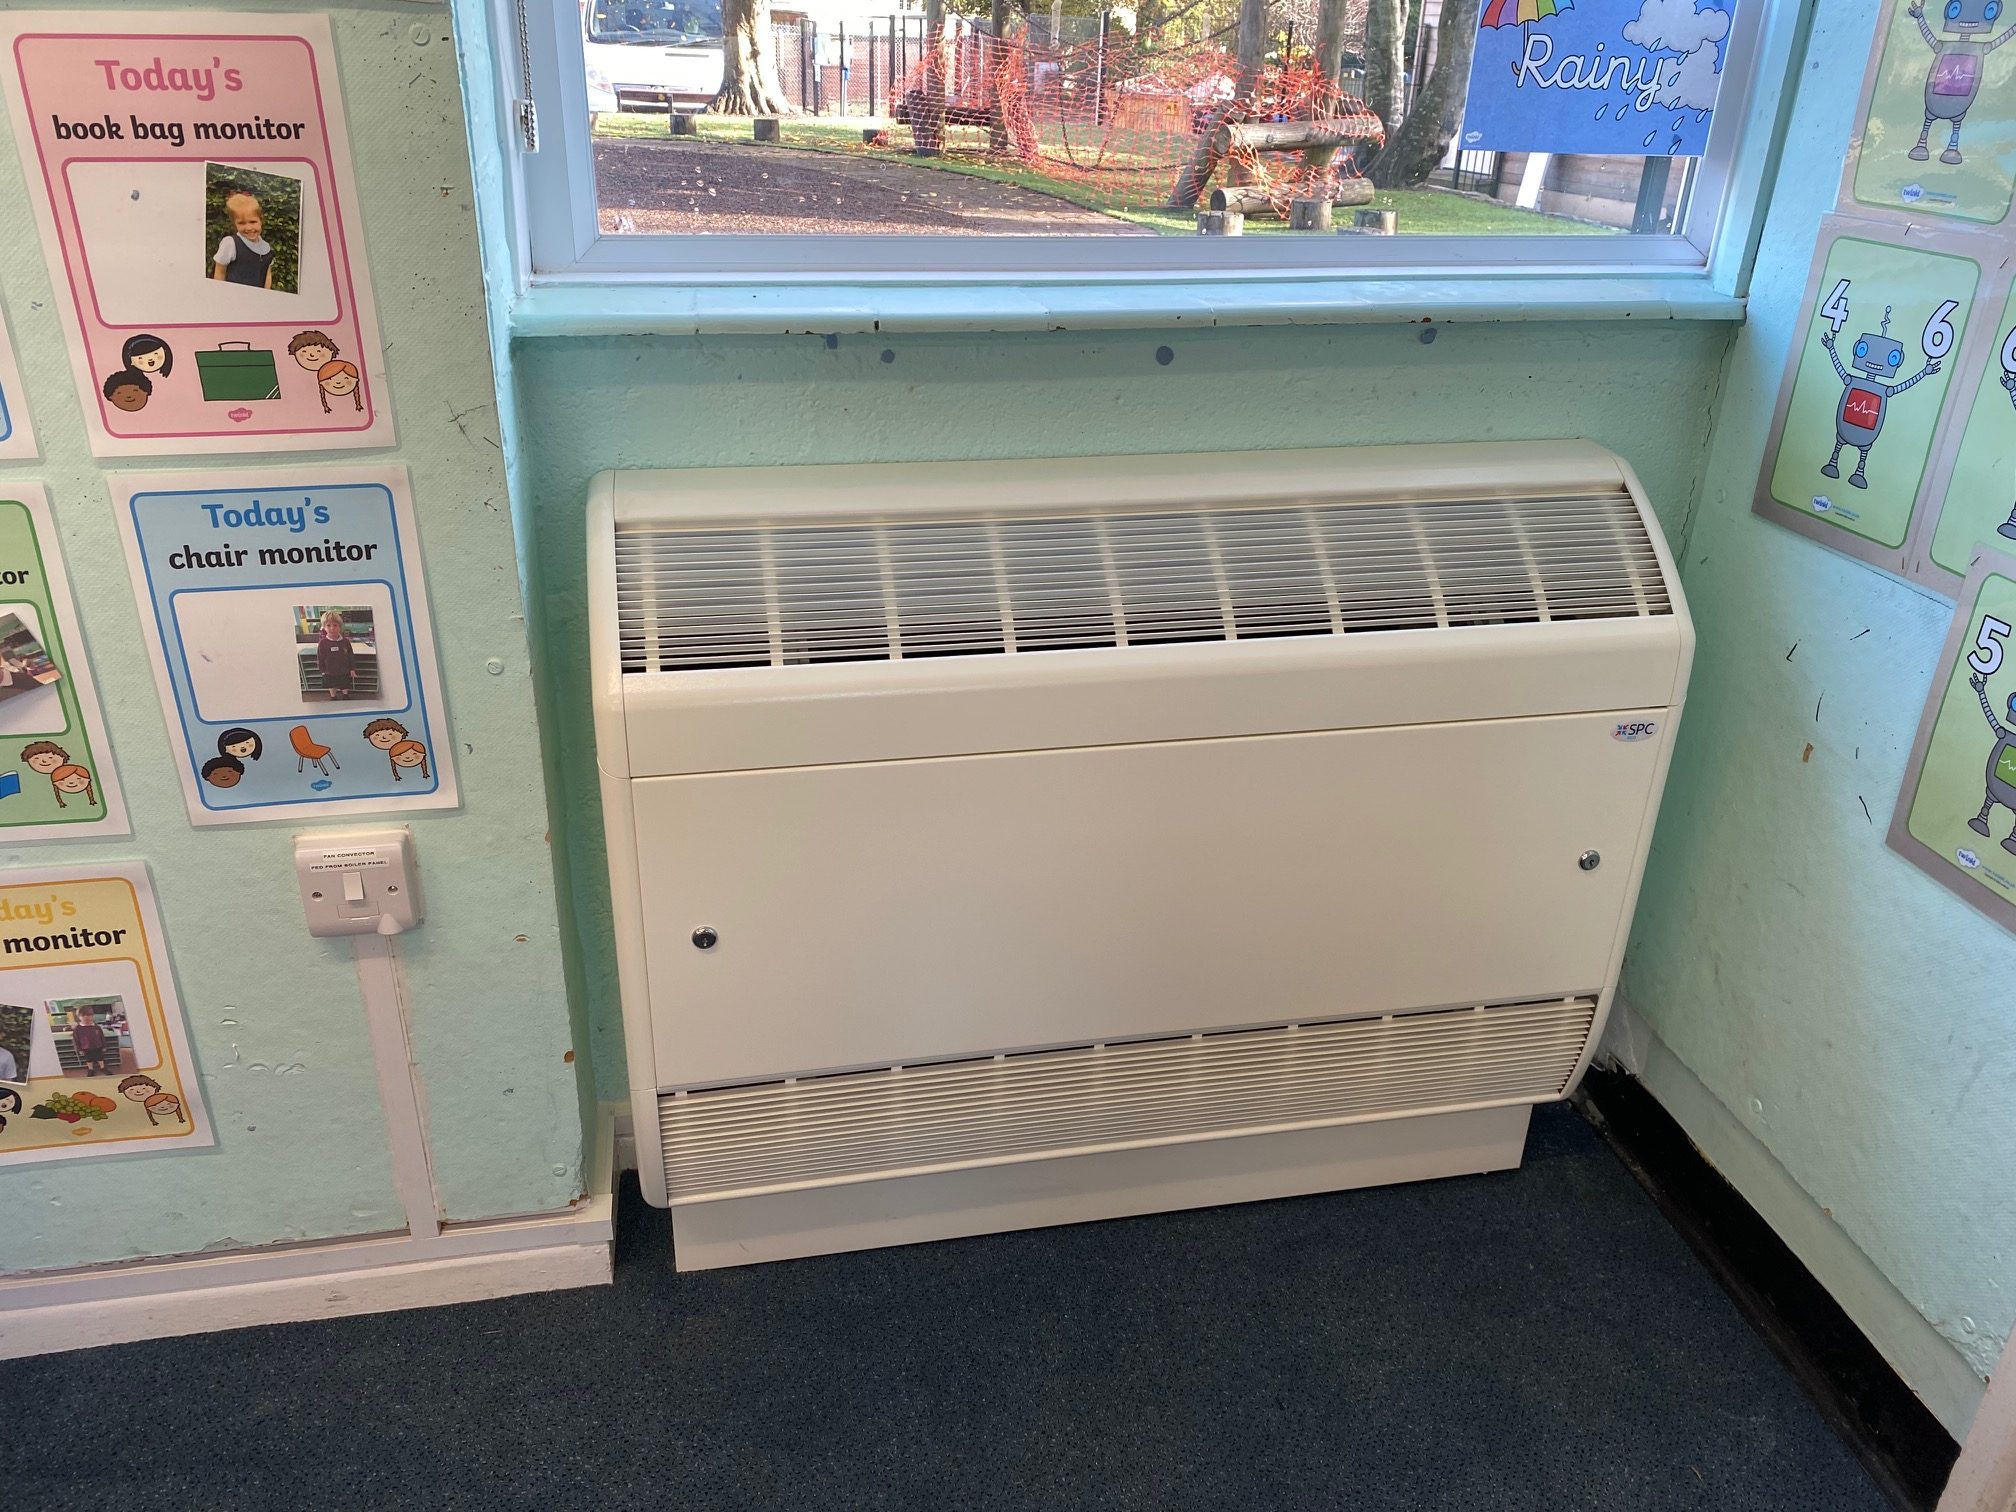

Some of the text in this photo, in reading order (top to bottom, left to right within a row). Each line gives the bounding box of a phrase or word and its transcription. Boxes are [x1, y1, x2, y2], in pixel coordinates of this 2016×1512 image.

[94, 57, 243, 101] Today's
[1517, 34, 1664, 111] Rainy
[52, 115, 305, 147] book bag monitor
[1820, 279, 1851, 333] 4
[1921, 300, 1959, 359] 6
[201, 497, 330, 533] Today's
[169, 539, 378, 570] chair monitor
[0, 570, 29, 585] or
[1967, 614, 2012, 675] 5
[1628, 722, 1655, 735] SPC
[3, 926, 127, 954] monitor
